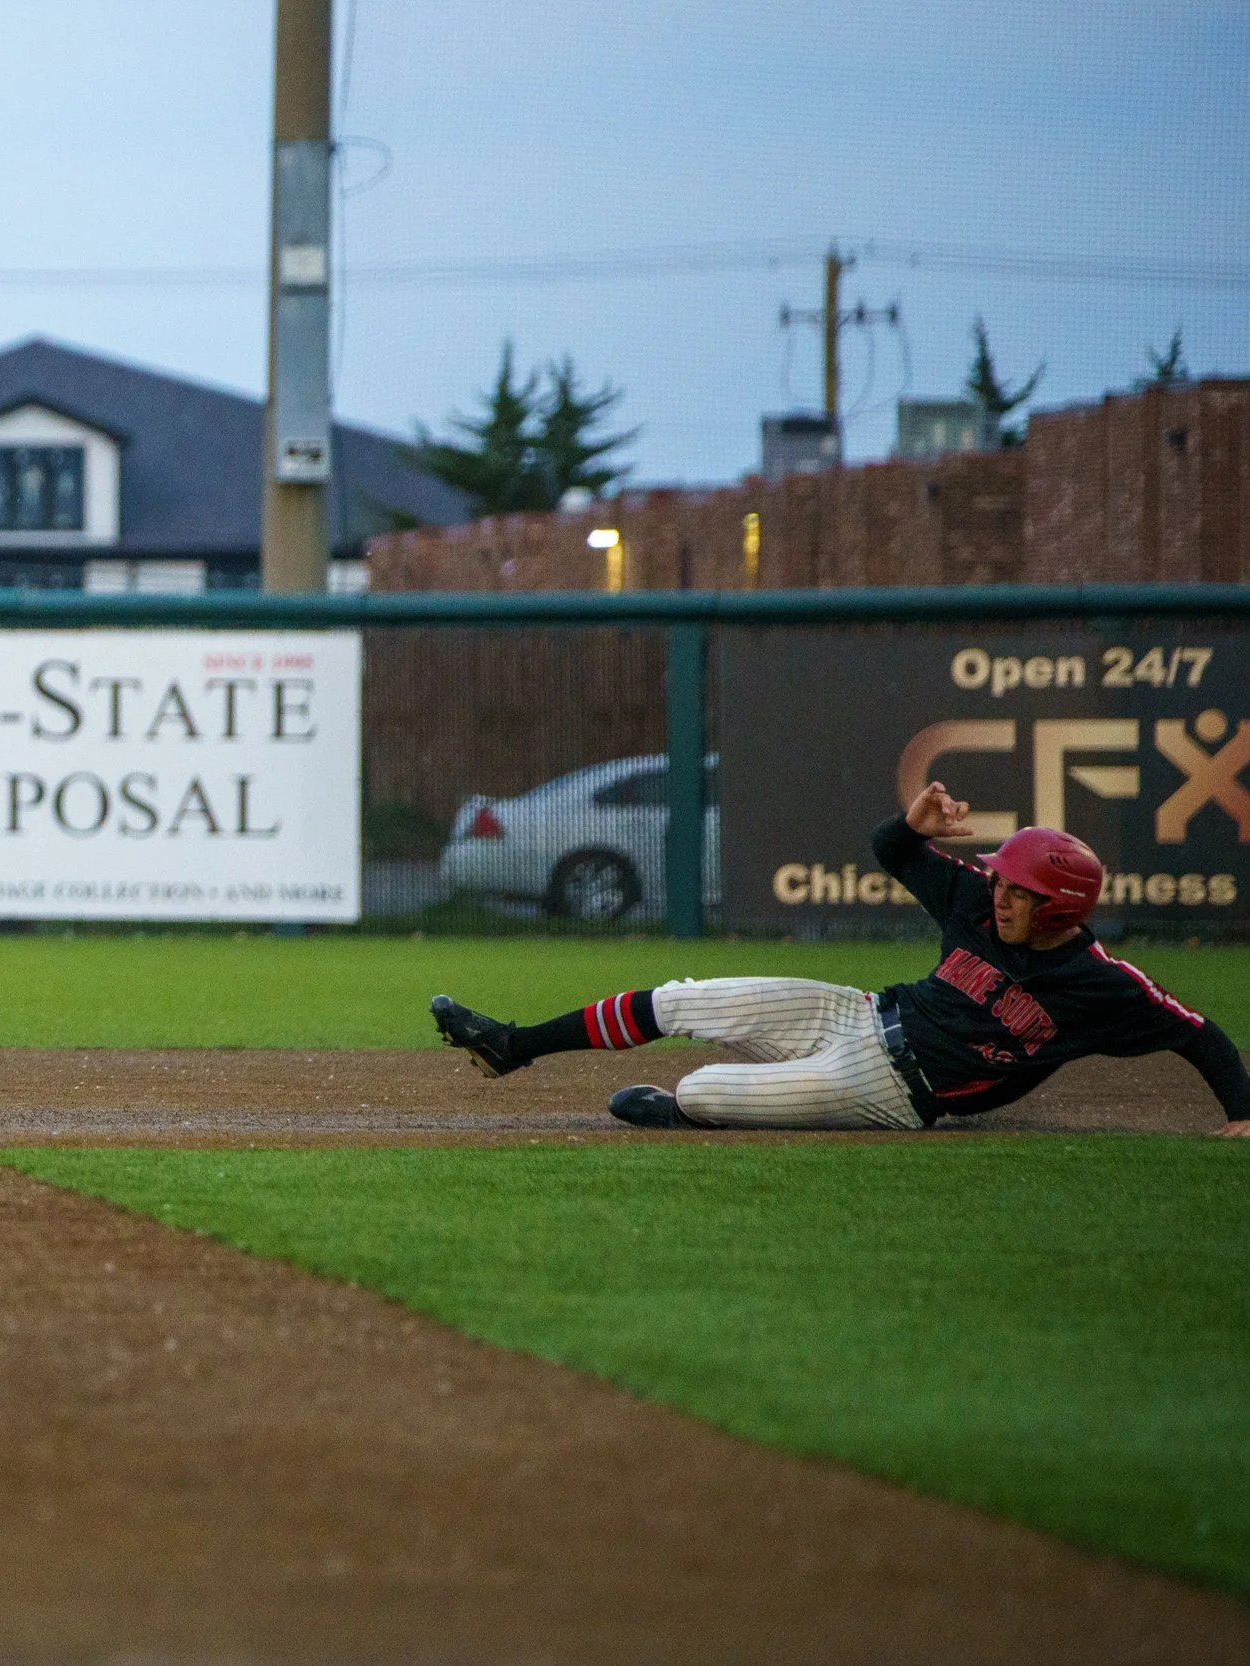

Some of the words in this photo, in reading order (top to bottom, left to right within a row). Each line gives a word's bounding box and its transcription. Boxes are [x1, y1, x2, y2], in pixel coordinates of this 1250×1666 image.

[952, 646, 1086, 697] Open
[1102, 646, 1213, 688] 24/7
[991, 983, 1058, 1056] SOUTH
